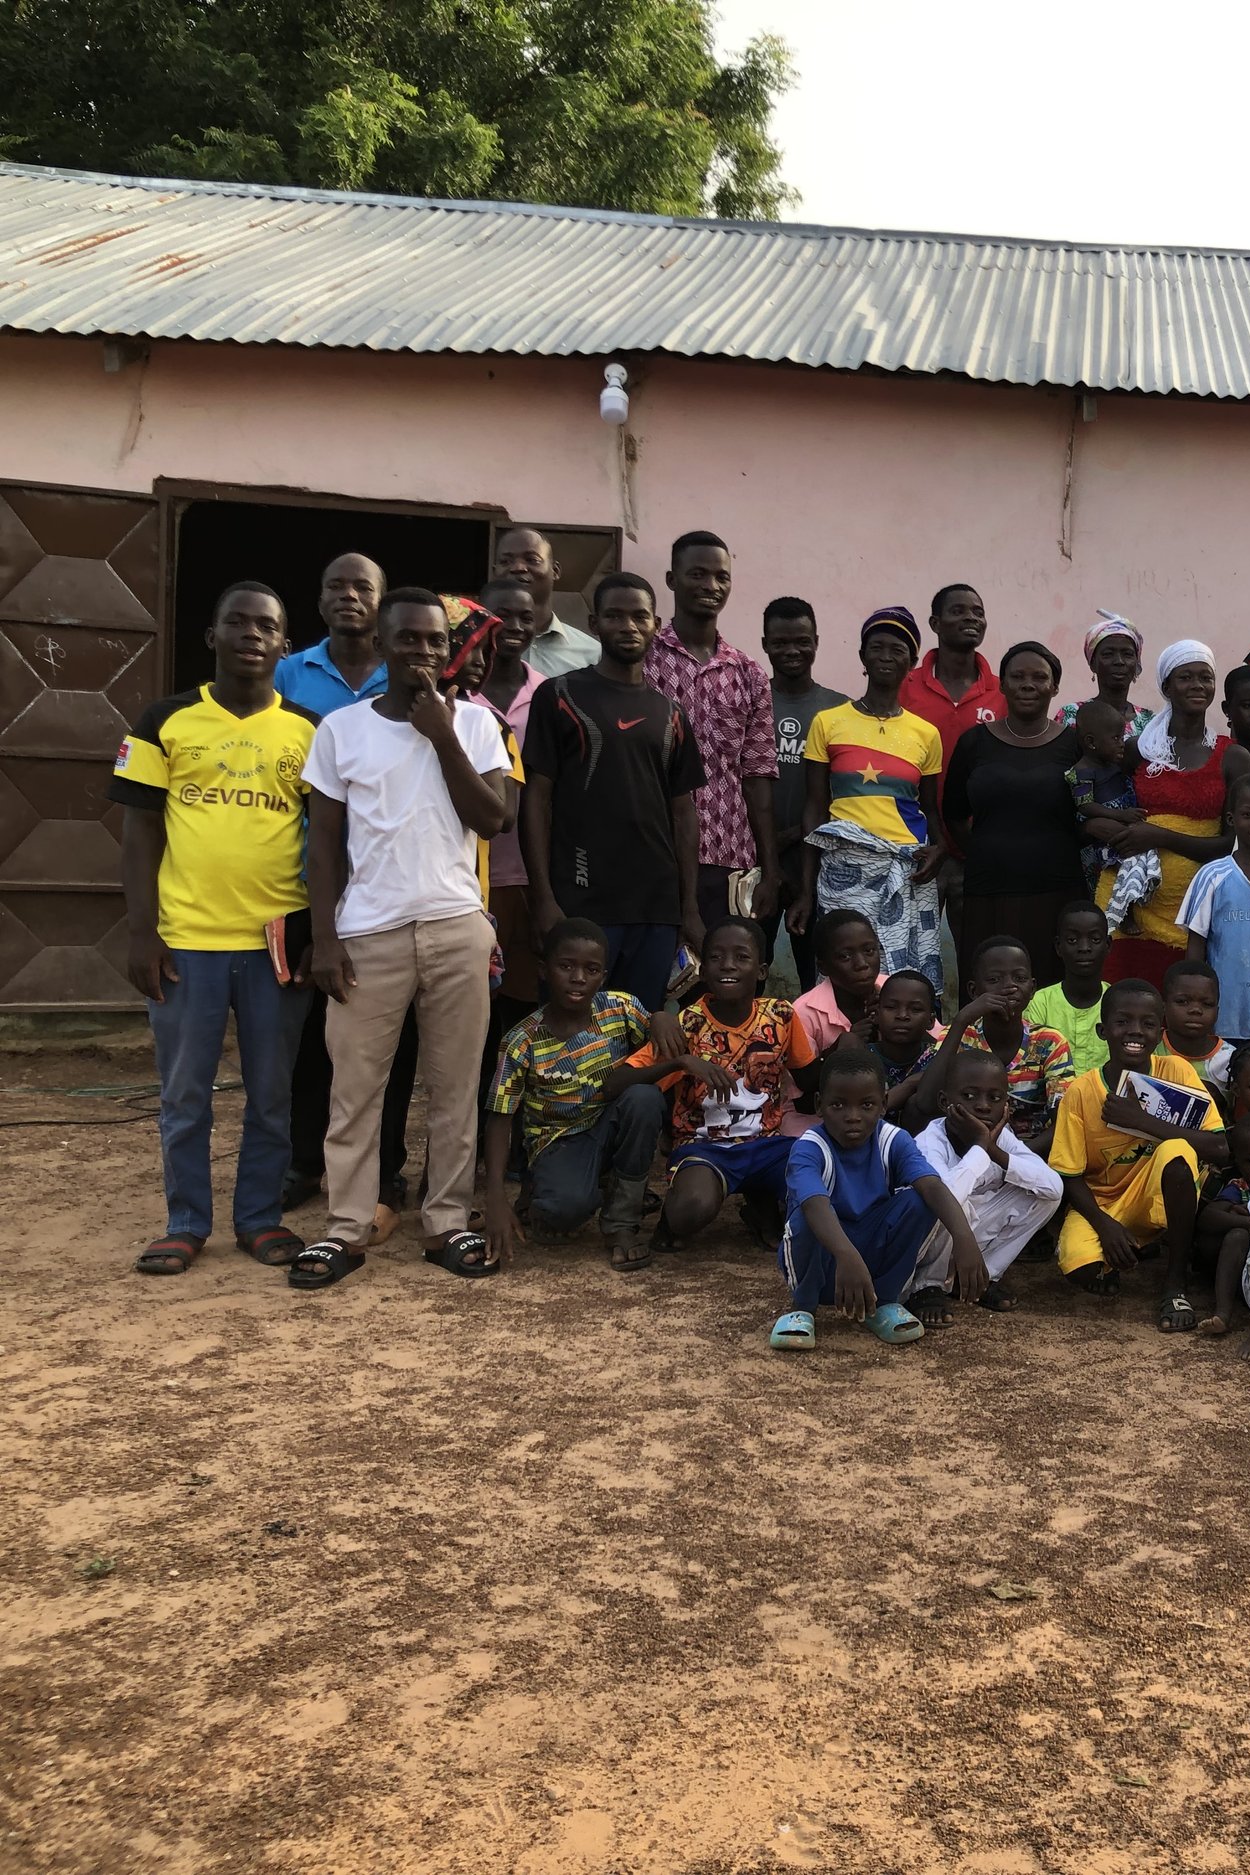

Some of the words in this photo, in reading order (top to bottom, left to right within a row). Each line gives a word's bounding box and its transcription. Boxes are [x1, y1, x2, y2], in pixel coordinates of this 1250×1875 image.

[280, 758, 299, 776] BVB
[776, 753, 801, 764] ARIS
[202, 787, 289, 813] EVONIK
[576, 847, 588, 887] NIKE
